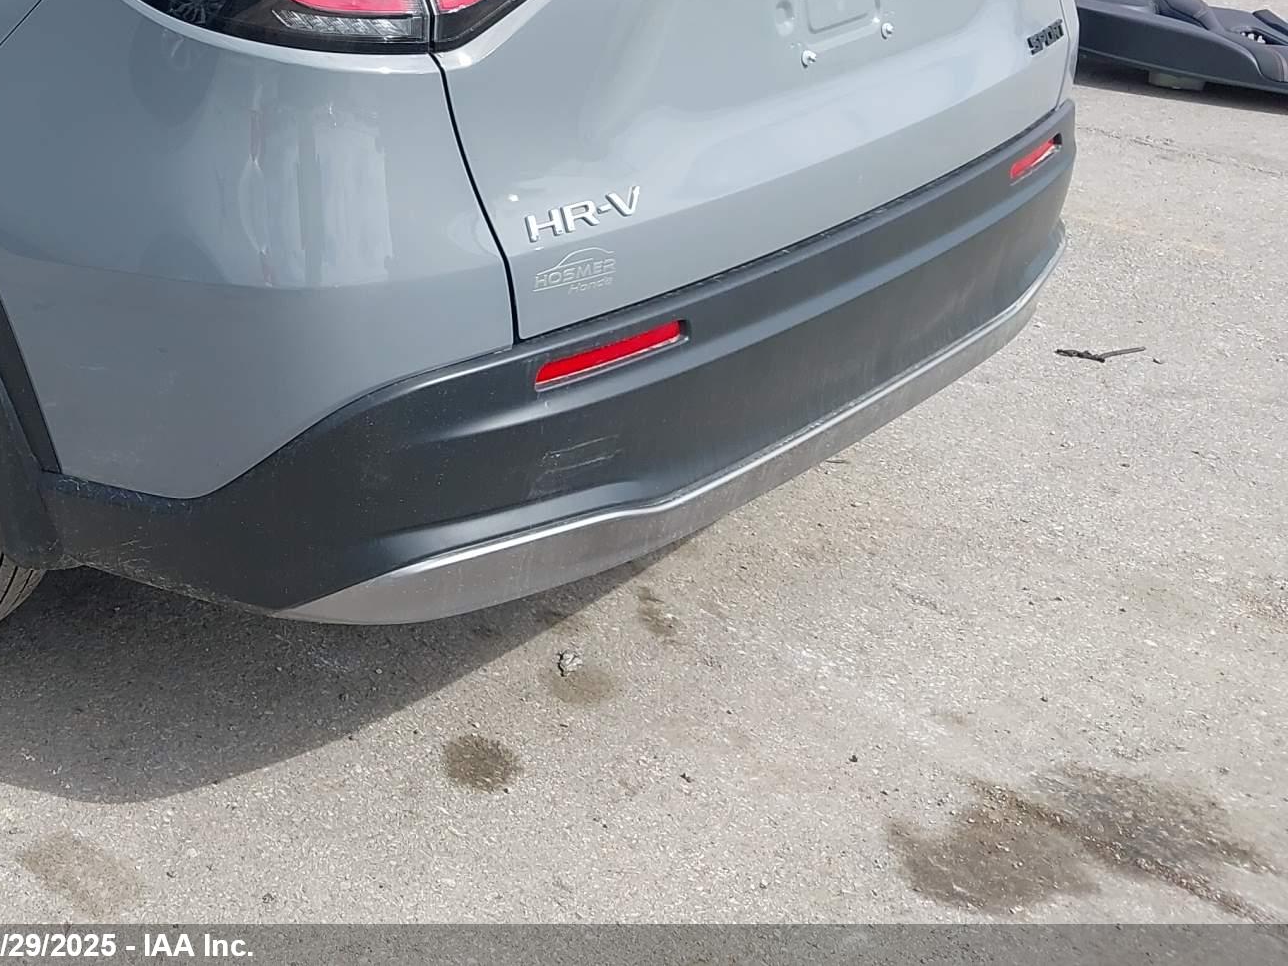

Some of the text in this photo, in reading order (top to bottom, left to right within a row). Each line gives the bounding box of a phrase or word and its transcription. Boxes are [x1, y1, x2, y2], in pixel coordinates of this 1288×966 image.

[1026, 18, 1065, 56] SPORT
[524, 185, 641, 243] HR-V
[534, 257, 616, 289] HOSMER
